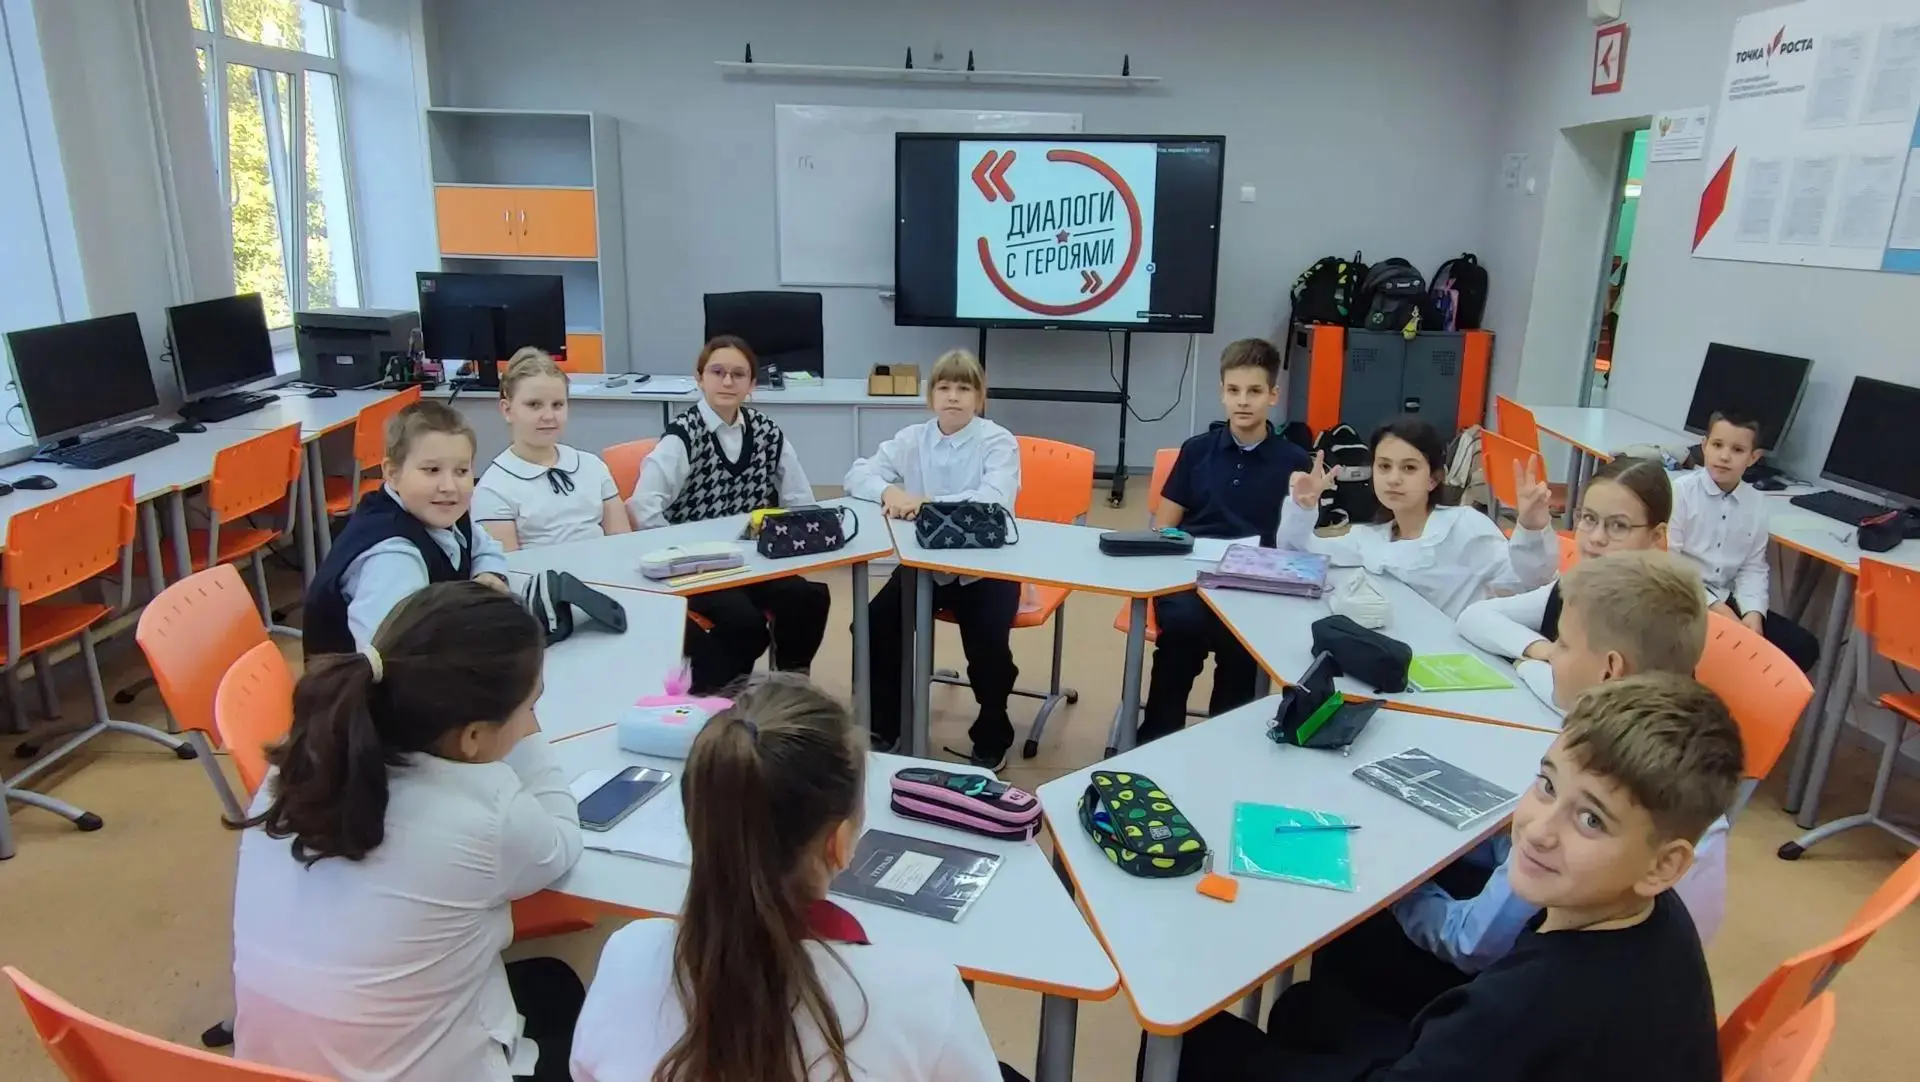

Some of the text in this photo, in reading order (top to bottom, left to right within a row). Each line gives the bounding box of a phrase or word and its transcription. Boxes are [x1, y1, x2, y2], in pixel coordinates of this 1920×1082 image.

[1736, 37, 1813, 64] ТОЧКА РОСТА
[1007, 190, 1115, 240] ДИАЛОГИ
[1006, 238, 1114, 278] С ГЕРОЯМИ
